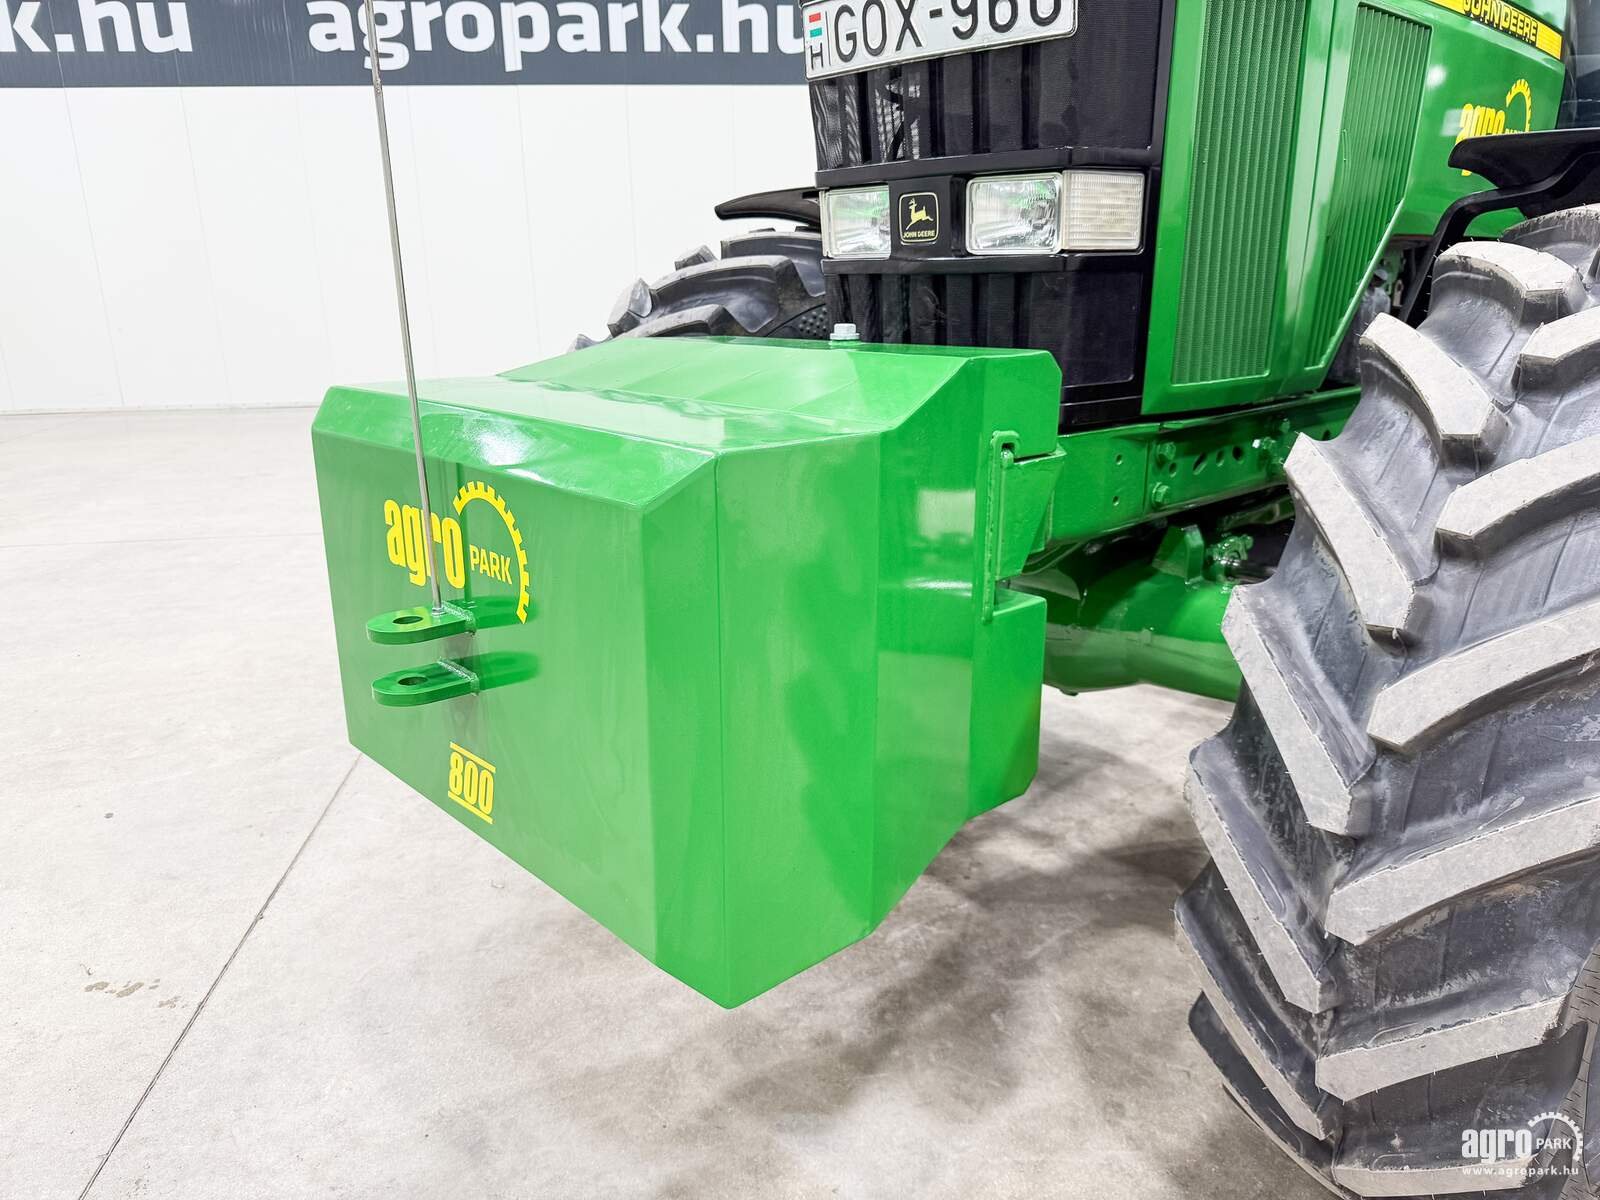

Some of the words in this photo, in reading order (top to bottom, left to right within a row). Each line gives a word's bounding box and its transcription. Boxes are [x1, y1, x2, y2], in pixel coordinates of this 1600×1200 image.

[1501, 4, 1538, 42] DEERE
[809, 42, 824, 70] H
[384, 499, 465, 588] agro
[469, 544, 512, 585] PARK
[449, 751, 494, 815] 800
